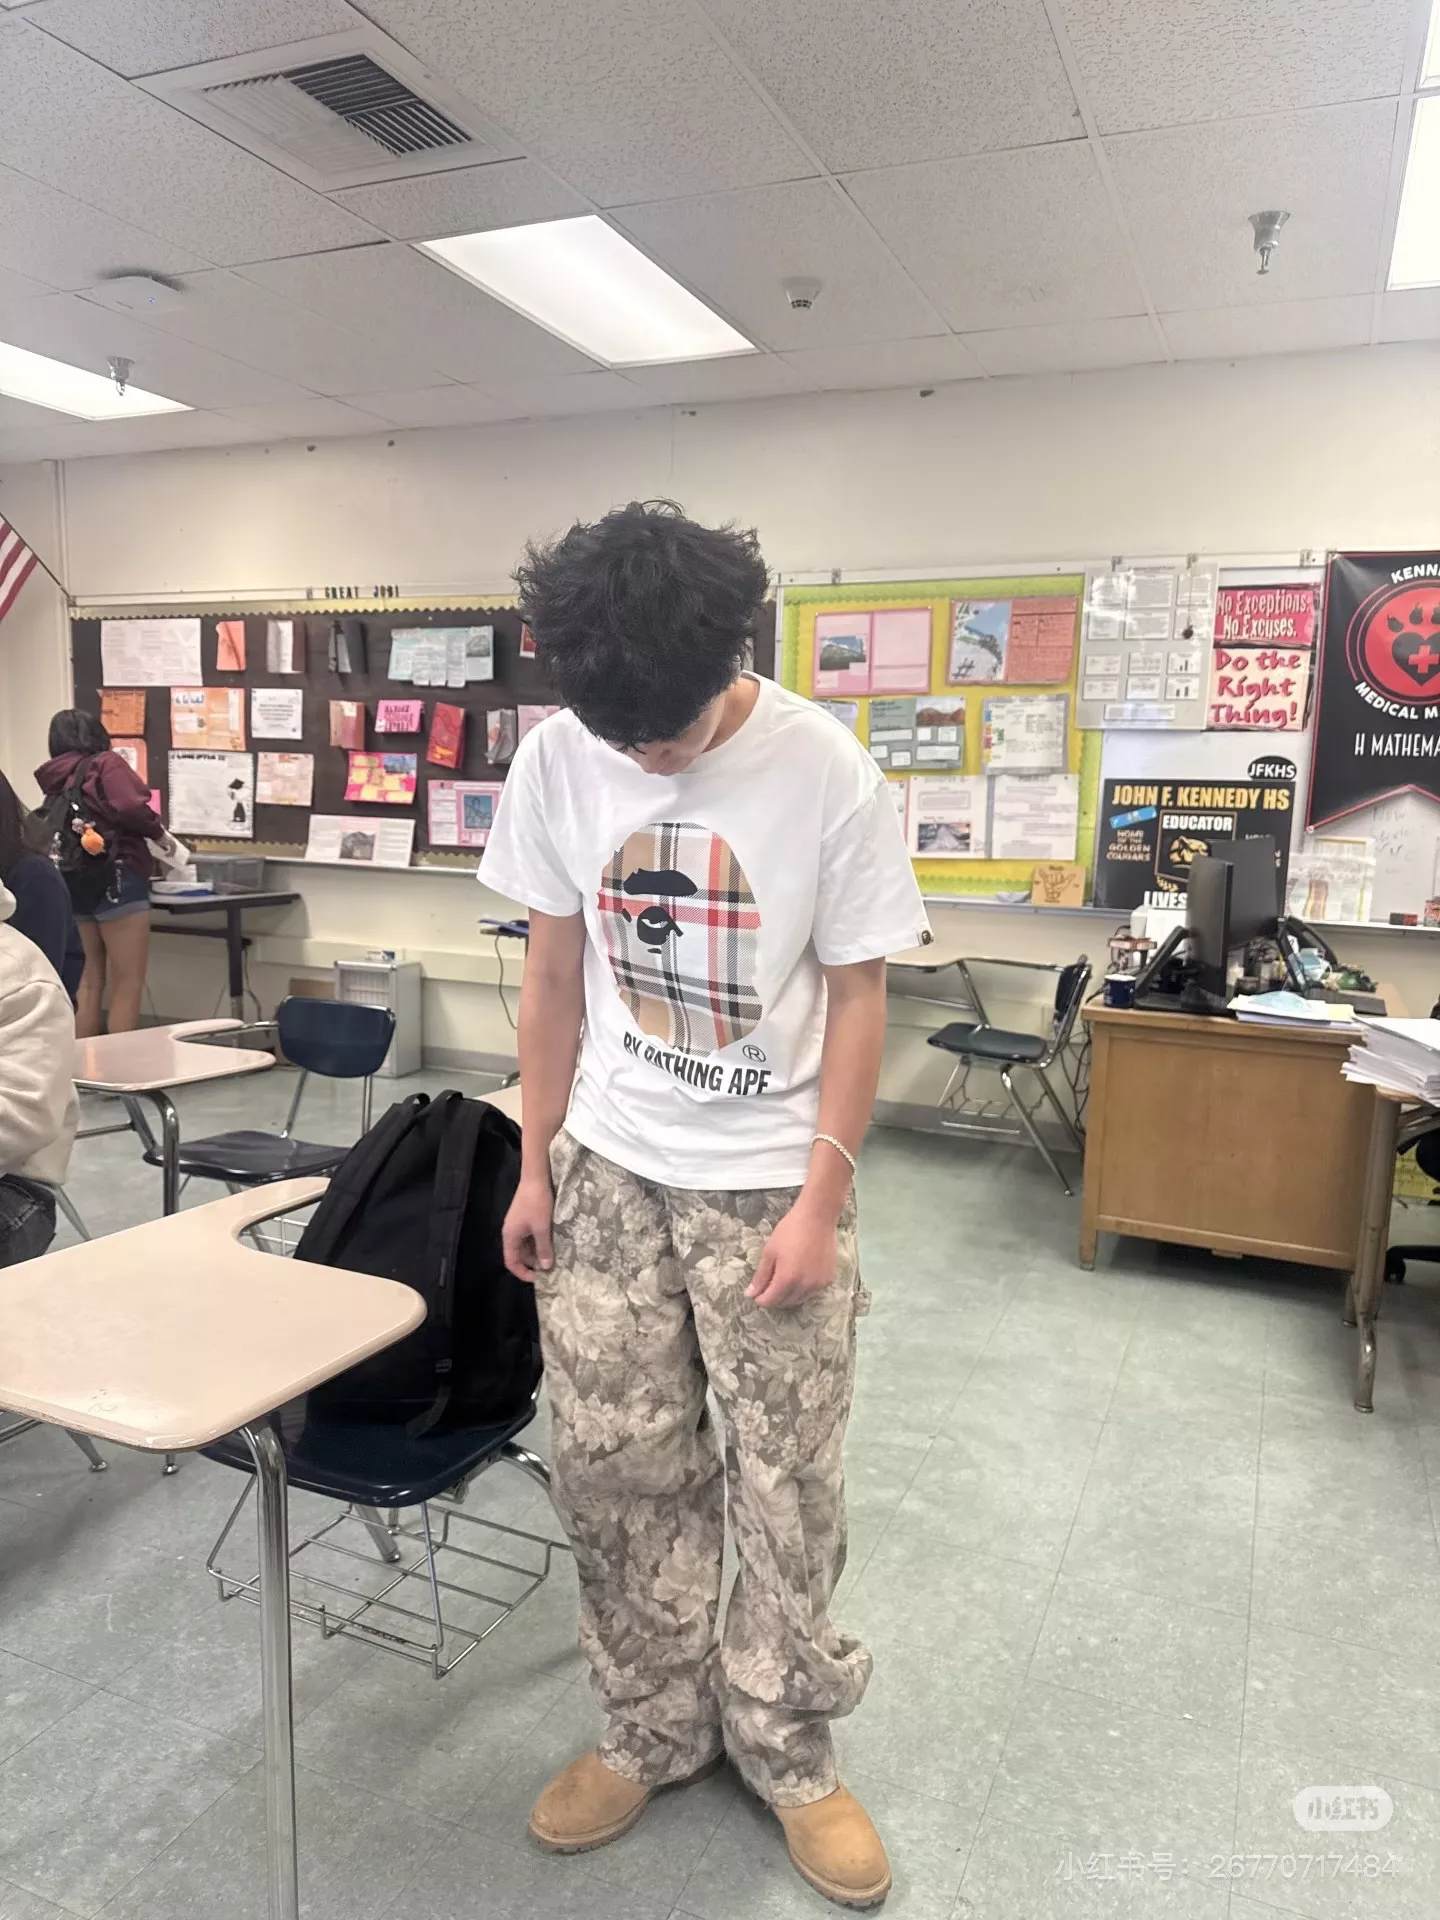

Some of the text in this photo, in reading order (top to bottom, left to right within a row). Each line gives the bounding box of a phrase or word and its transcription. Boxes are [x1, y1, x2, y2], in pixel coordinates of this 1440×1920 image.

[1391, 563, 1440, 584] KENN
[325, 586, 359, 600] GREAT
[1217, 592, 1232, 615] No
[1223, 615, 1297, 640] No Excuses.
[1215, 650, 1301, 671] Do the
[1218, 675, 1297, 704] Right
[1354, 681, 1419, 719] MEDICAL
[1211, 701, 1298, 729] Thing!
[1354, 732, 1366, 756] H
[1249, 763, 1295, 778] JFKHS
[1112, 785, 1291, 810] JOHN F. KENNEDY HS
[1162, 815, 1233, 831] EDUCATOR
